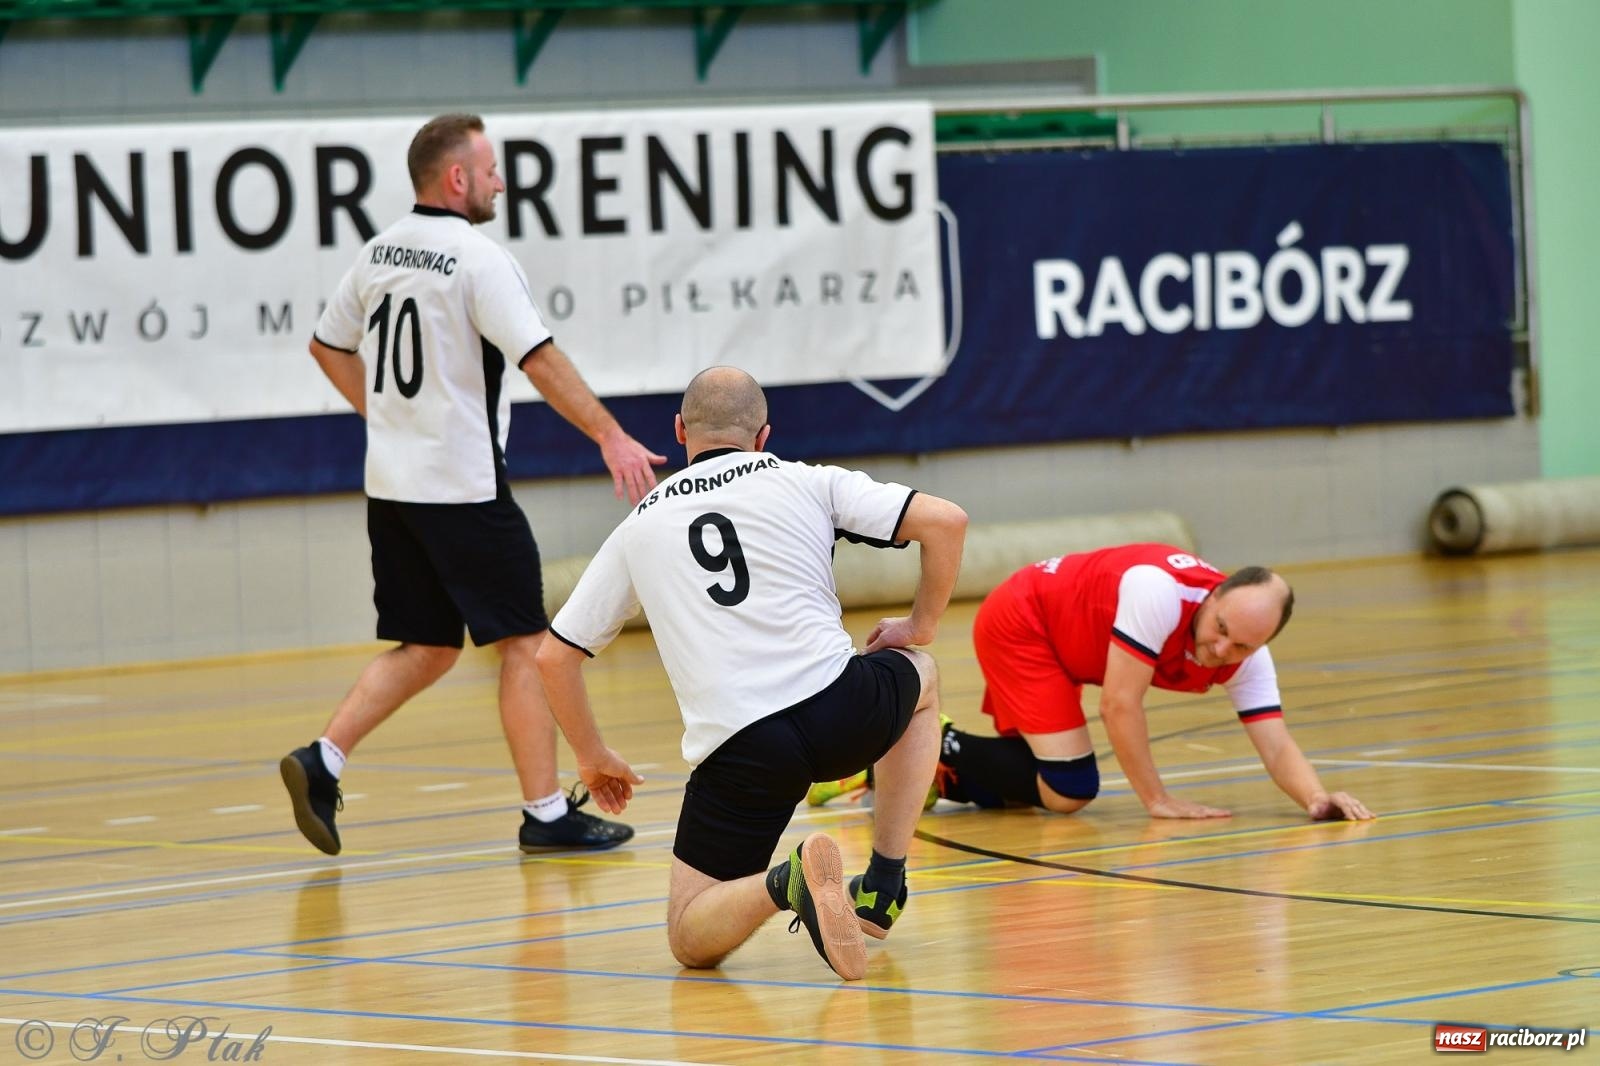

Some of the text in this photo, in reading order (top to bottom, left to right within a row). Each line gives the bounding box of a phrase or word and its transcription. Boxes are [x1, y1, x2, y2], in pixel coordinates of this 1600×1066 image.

[503, 126, 916, 239] RENING
[0, 300, 208, 347] ZWÓJ
[622, 269, 921, 317] PIŁKARZA
[370, 245, 457, 276] KS KORNOWAC
[1033, 220, 1413, 340] RACIBÓRZ
[368, 293, 423, 399] 10
[688, 512, 750, 607] 9
